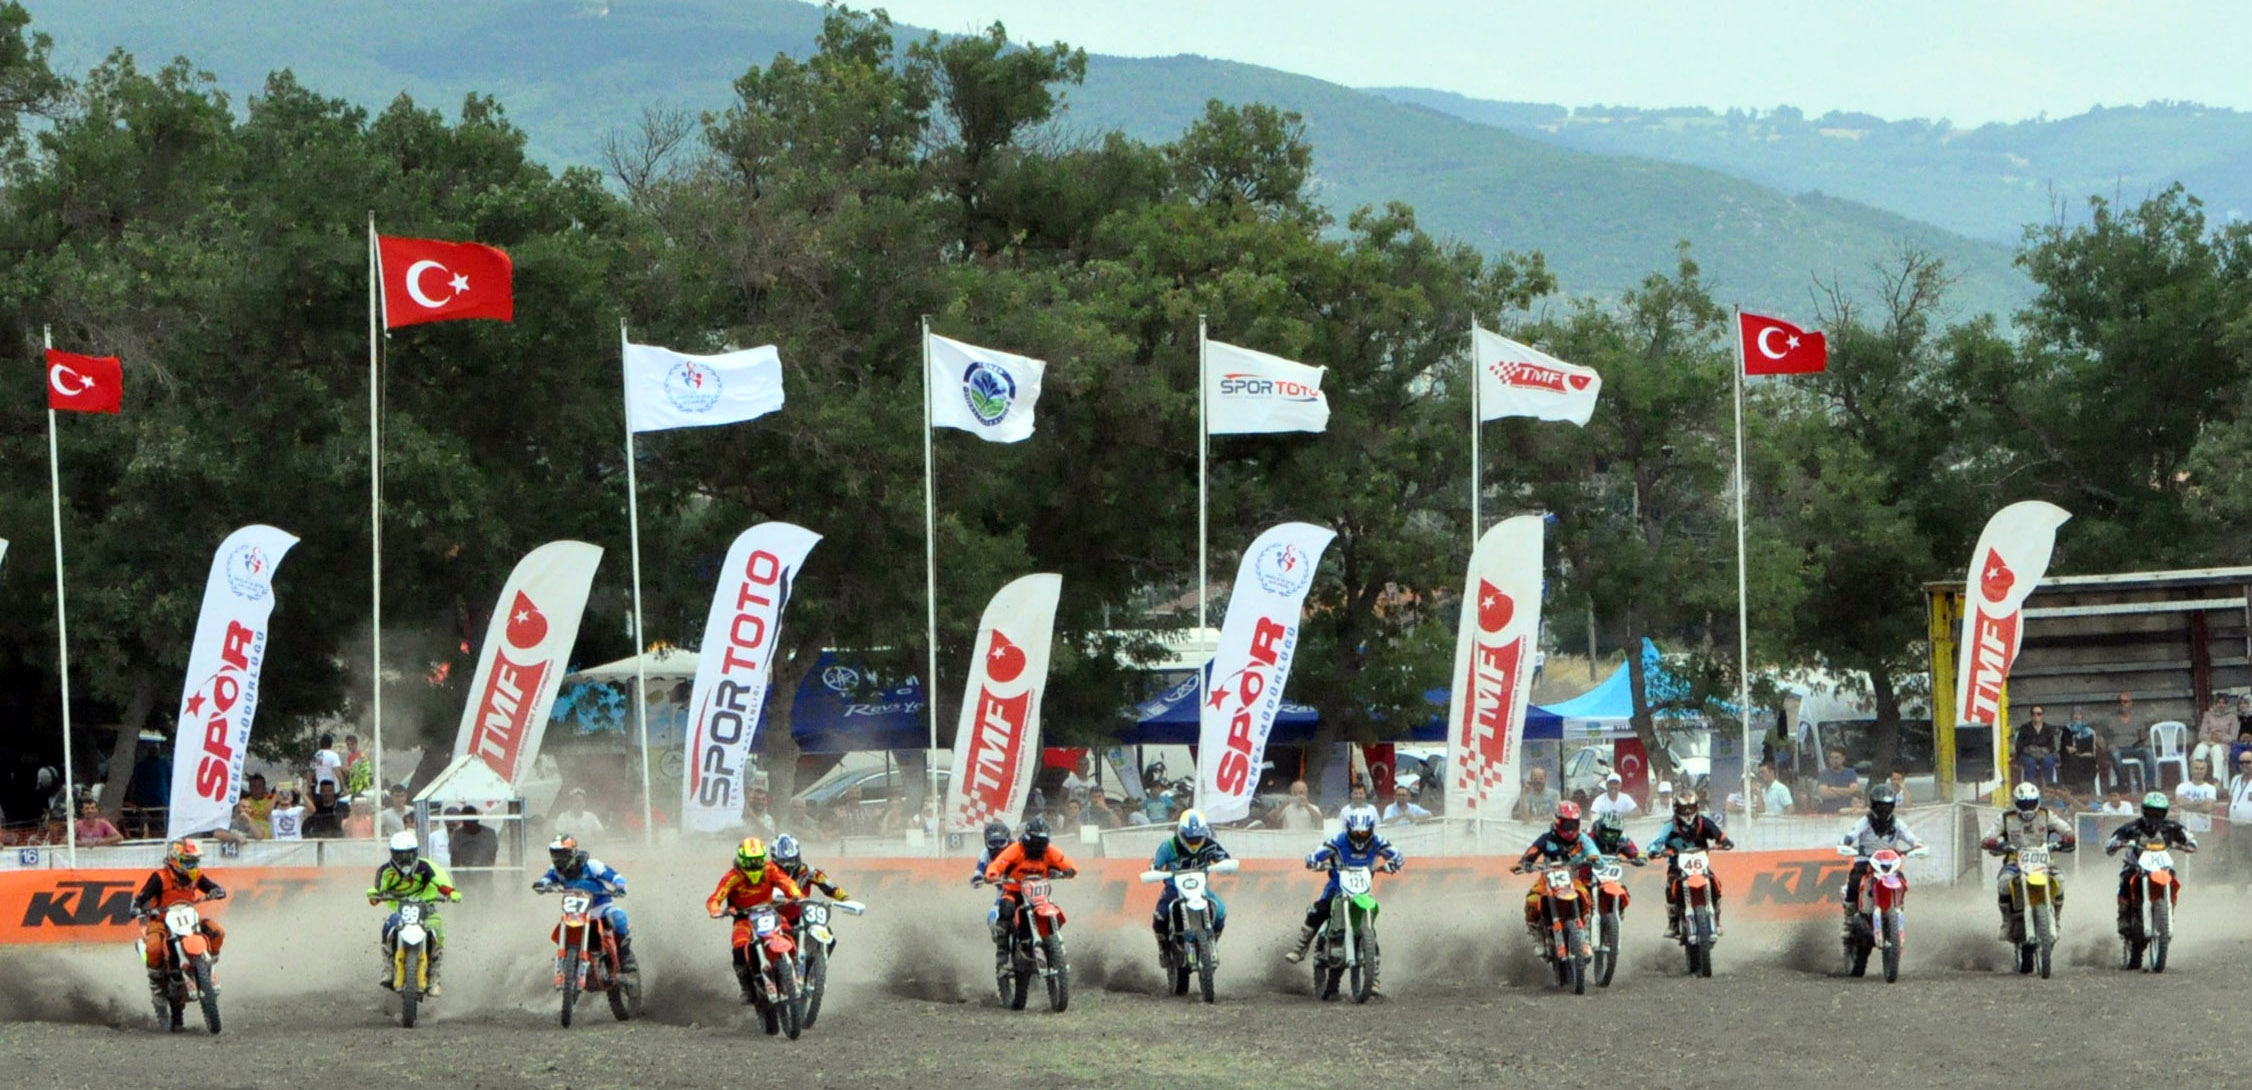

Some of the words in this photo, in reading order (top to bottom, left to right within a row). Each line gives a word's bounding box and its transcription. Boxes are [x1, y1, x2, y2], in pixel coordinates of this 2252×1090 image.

[1521, 367, 1560, 384] TMF
[1972, 620, 2006, 714] TMF
[196, 619, 254, 803] SPOR
[477, 665, 524, 761] TMF
[1216, 616, 1286, 797] SPOR
[972, 699, 1013, 791] TMF
[229, 752, 243, 804] GENEL
[950, 834, 961, 848] 8
[21, 850, 37, 864] 16
[222, 843, 237, 857] 14
[1684, 859, 1703, 869] 46
[1547, 870, 1572, 887] 13
[563, 896, 590, 913] 27
[174, 914, 189, 927] 11
[805, 904, 827, 925] 39
